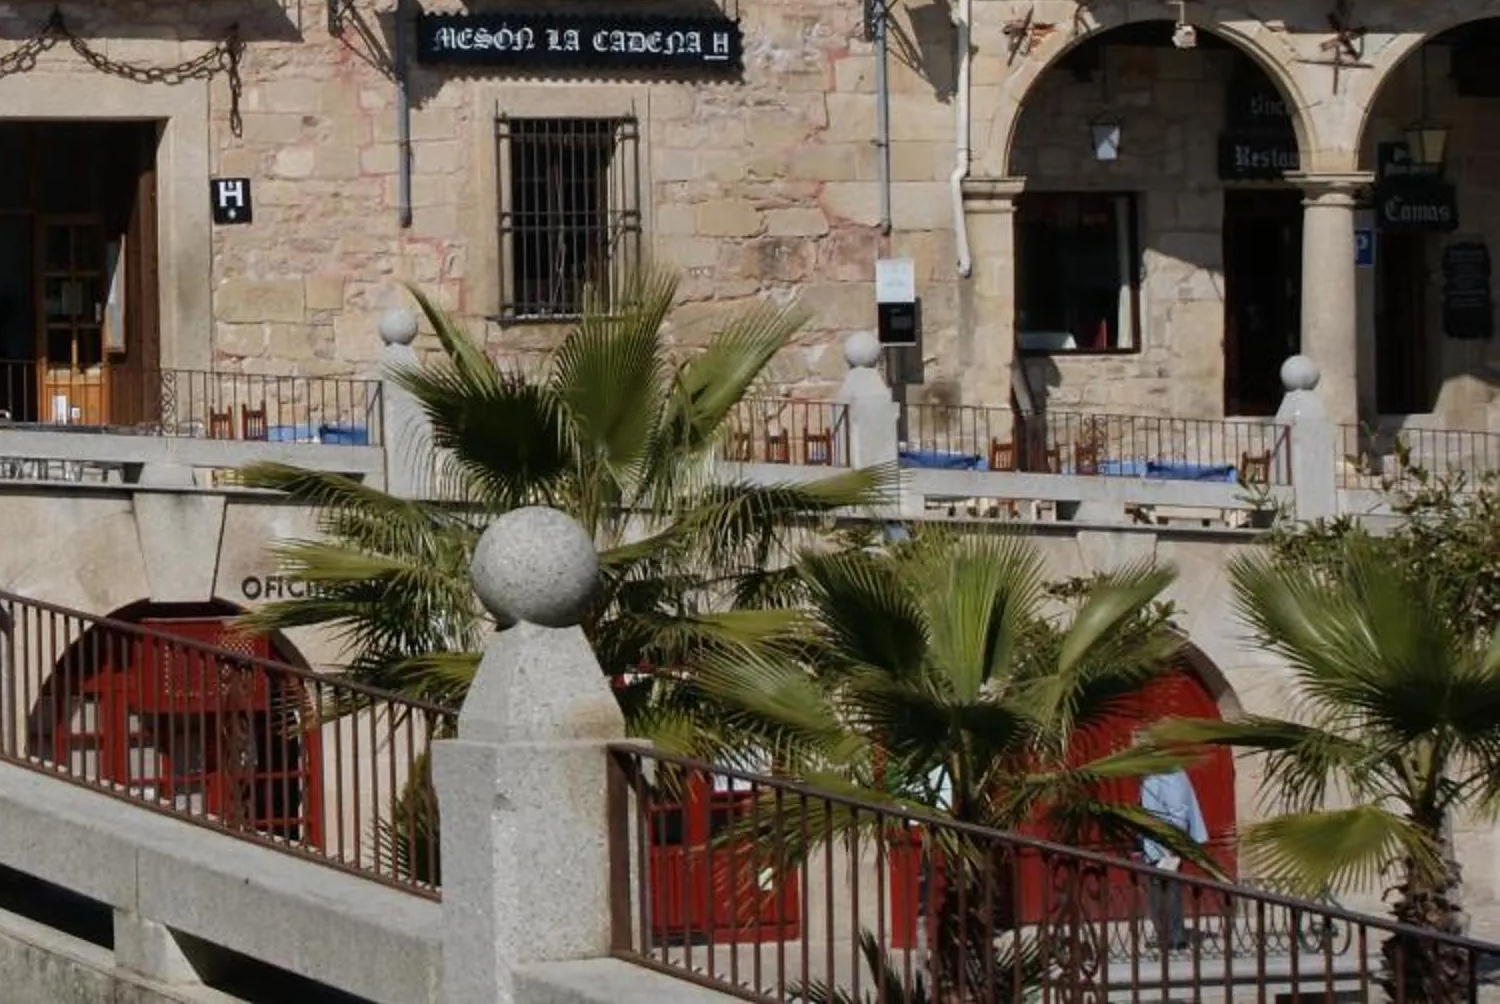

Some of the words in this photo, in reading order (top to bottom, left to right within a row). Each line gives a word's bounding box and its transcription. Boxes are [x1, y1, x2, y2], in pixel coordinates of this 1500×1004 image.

[546, 28, 581, 53] LA
[592, 29, 702, 55] CADENA
[1385, 193, 1451, 223] Camas
